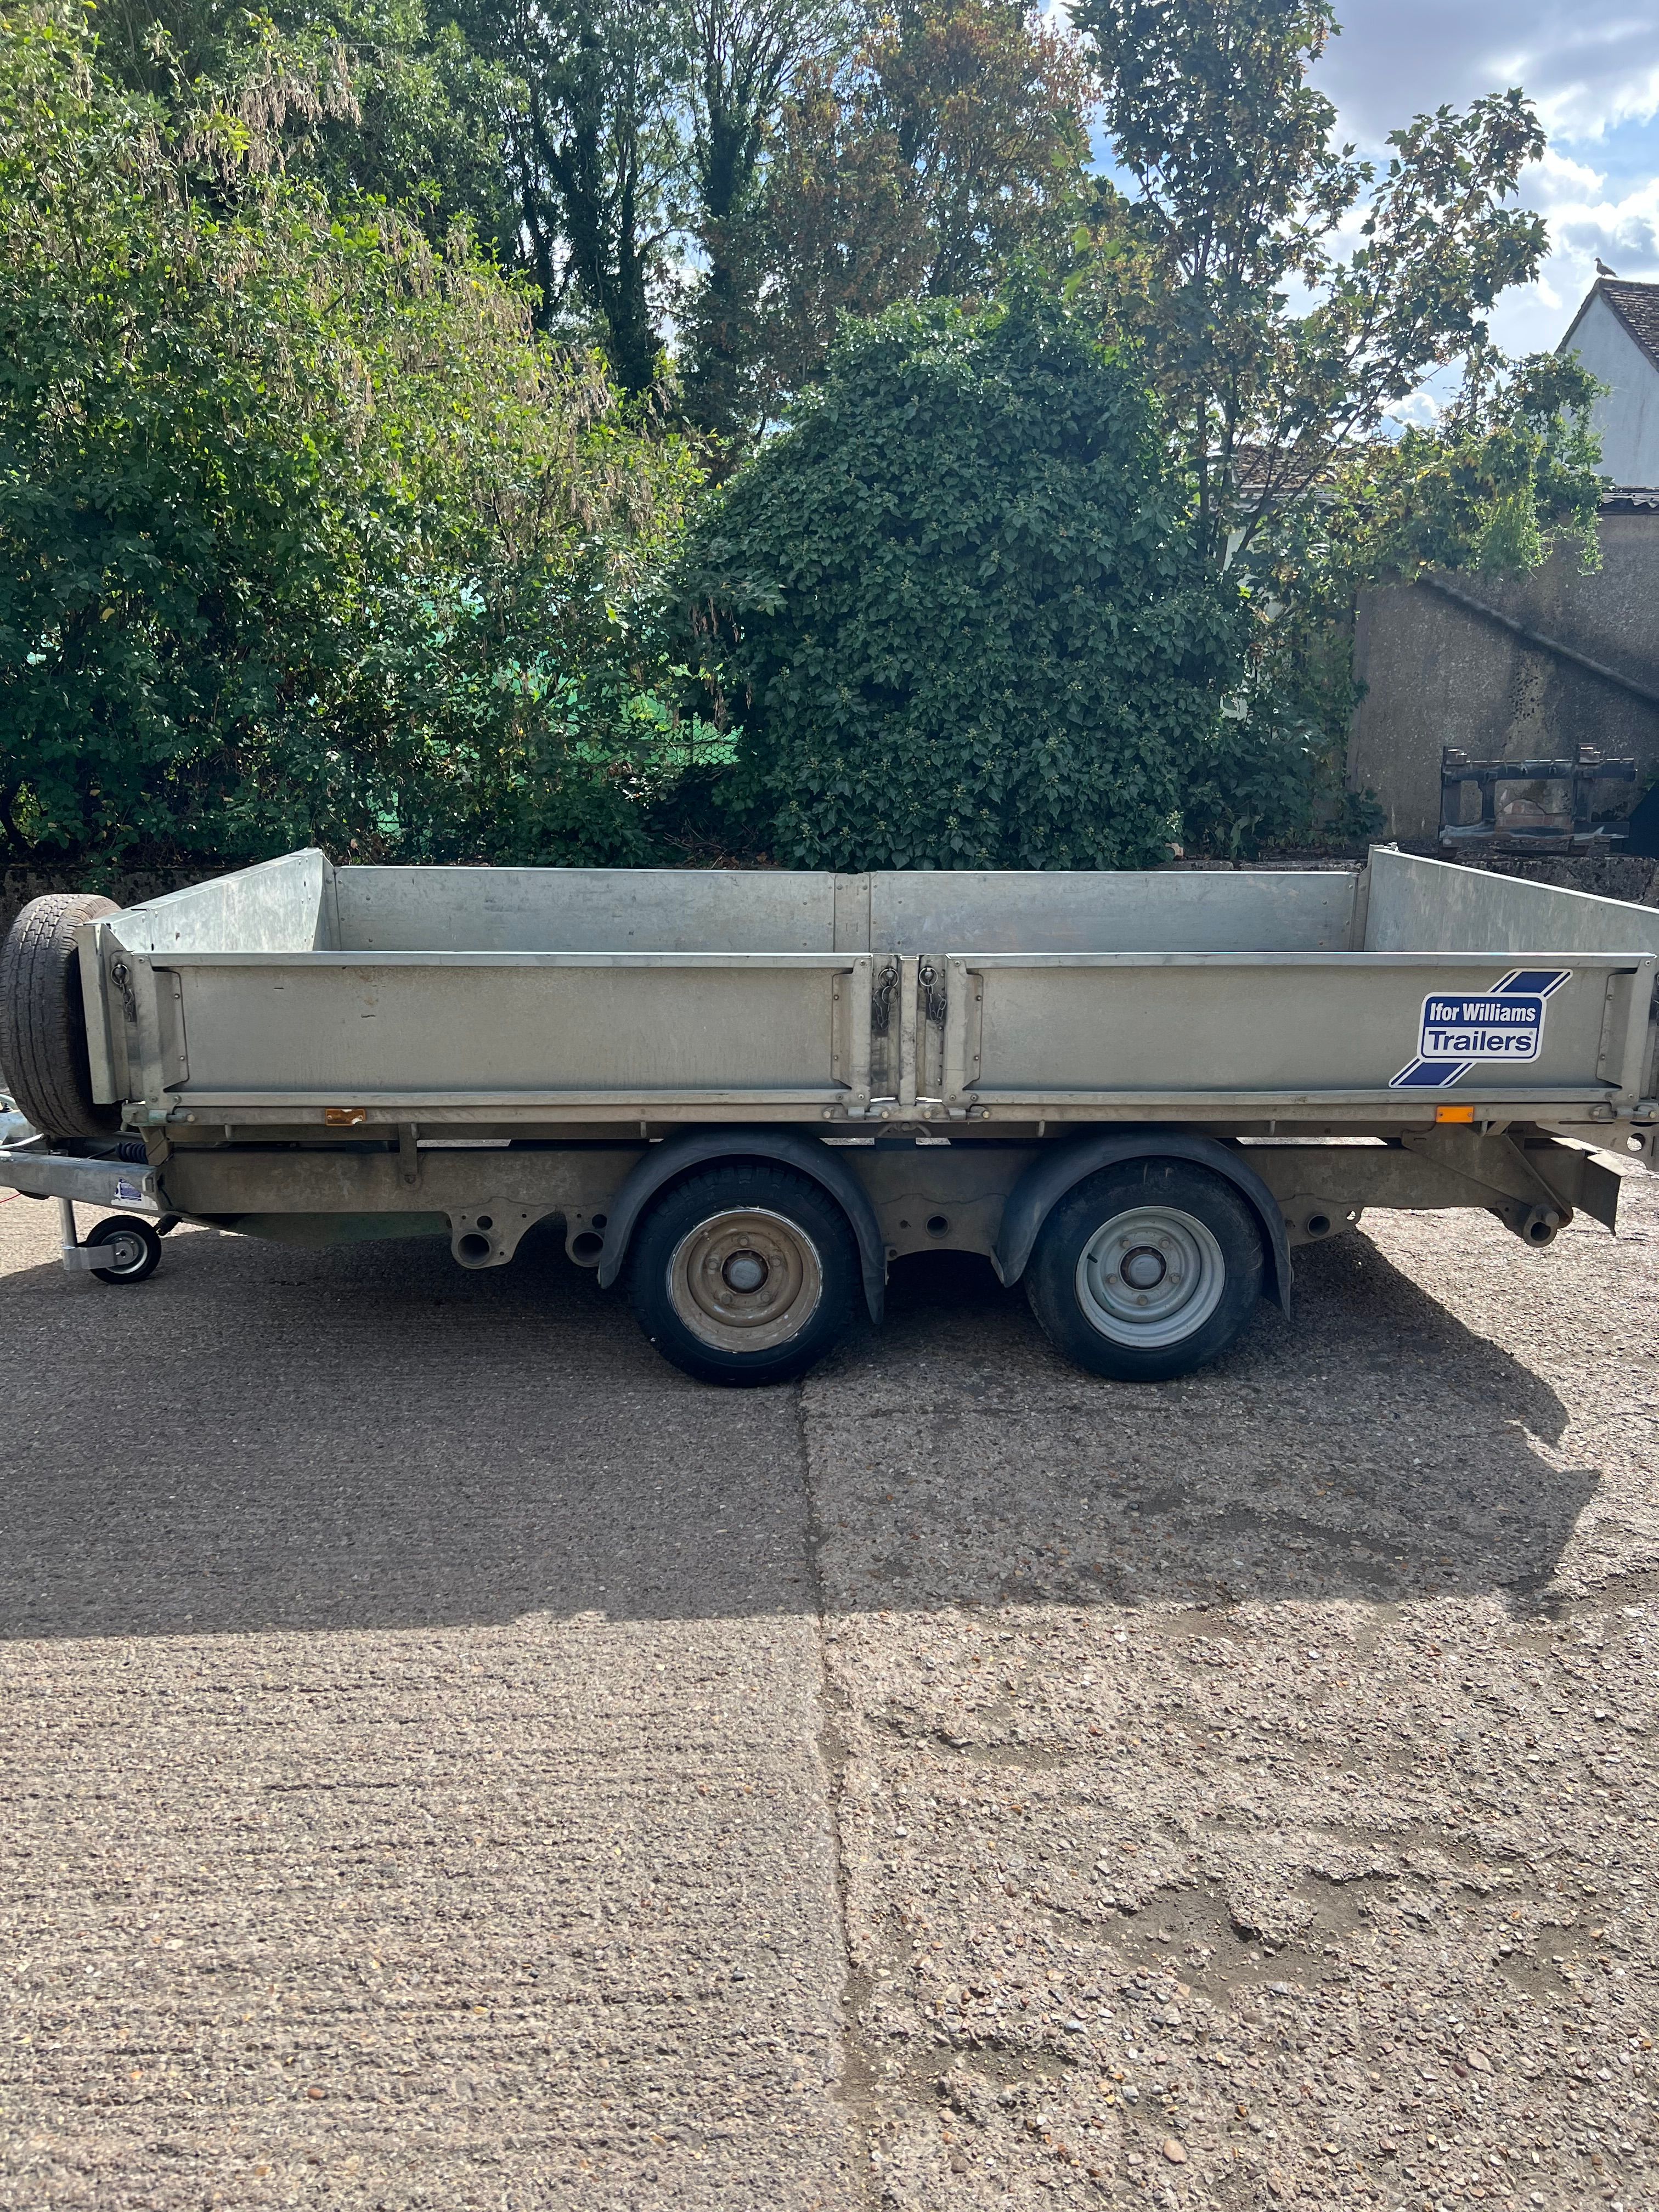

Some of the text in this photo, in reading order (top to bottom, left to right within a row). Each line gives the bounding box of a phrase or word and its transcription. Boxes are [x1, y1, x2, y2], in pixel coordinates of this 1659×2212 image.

[1429, 1003, 1536, 1022] Ifor Williams
[1428, 1030, 1532, 1051] Trailers
